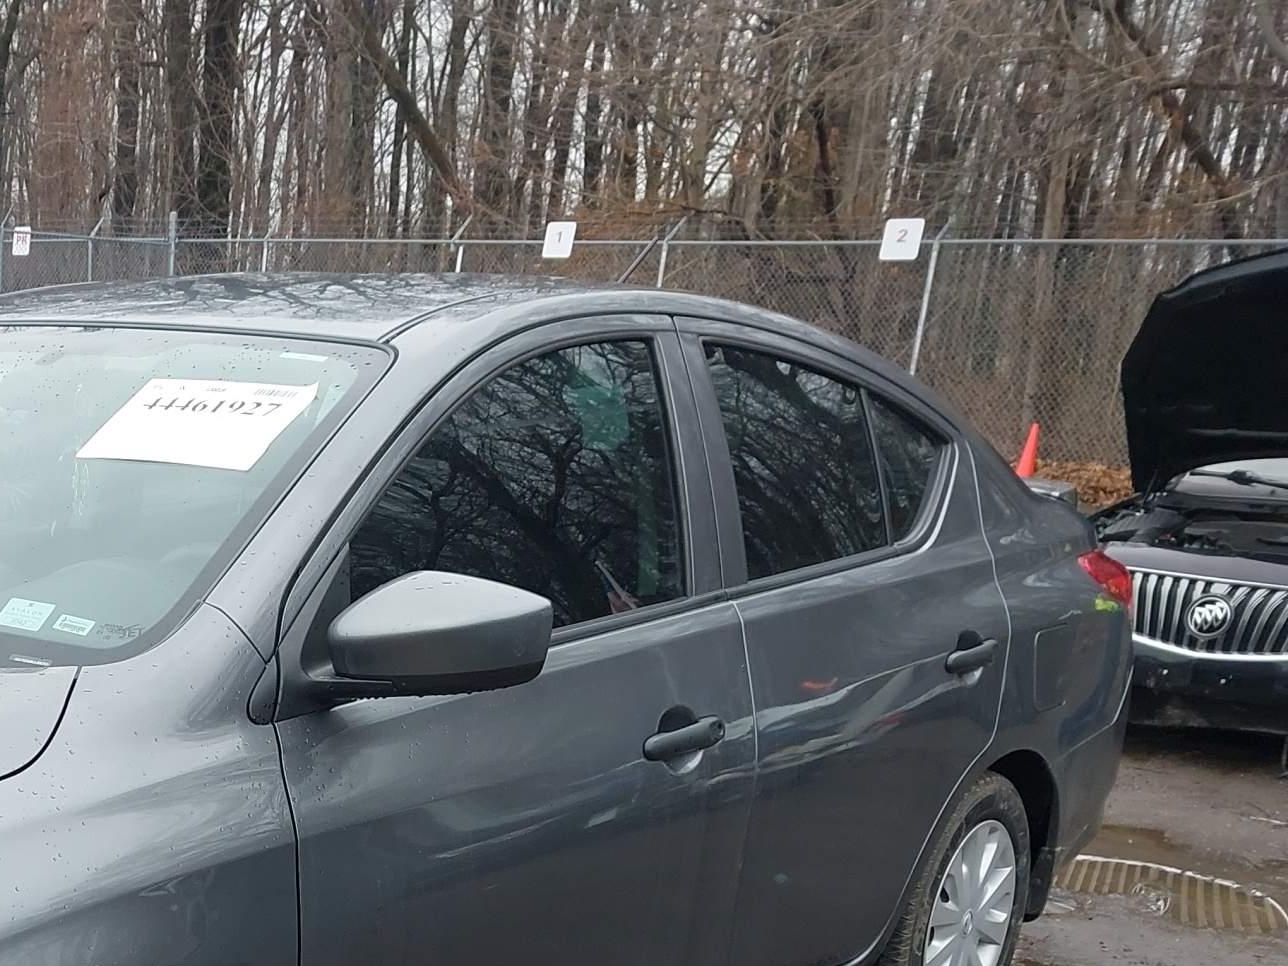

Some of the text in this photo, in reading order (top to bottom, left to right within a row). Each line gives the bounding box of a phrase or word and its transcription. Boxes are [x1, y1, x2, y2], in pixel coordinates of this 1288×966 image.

[555, 230, 563, 243] 1
[896, 228, 909, 243] 2
[143, 396, 283, 417] 44461927
